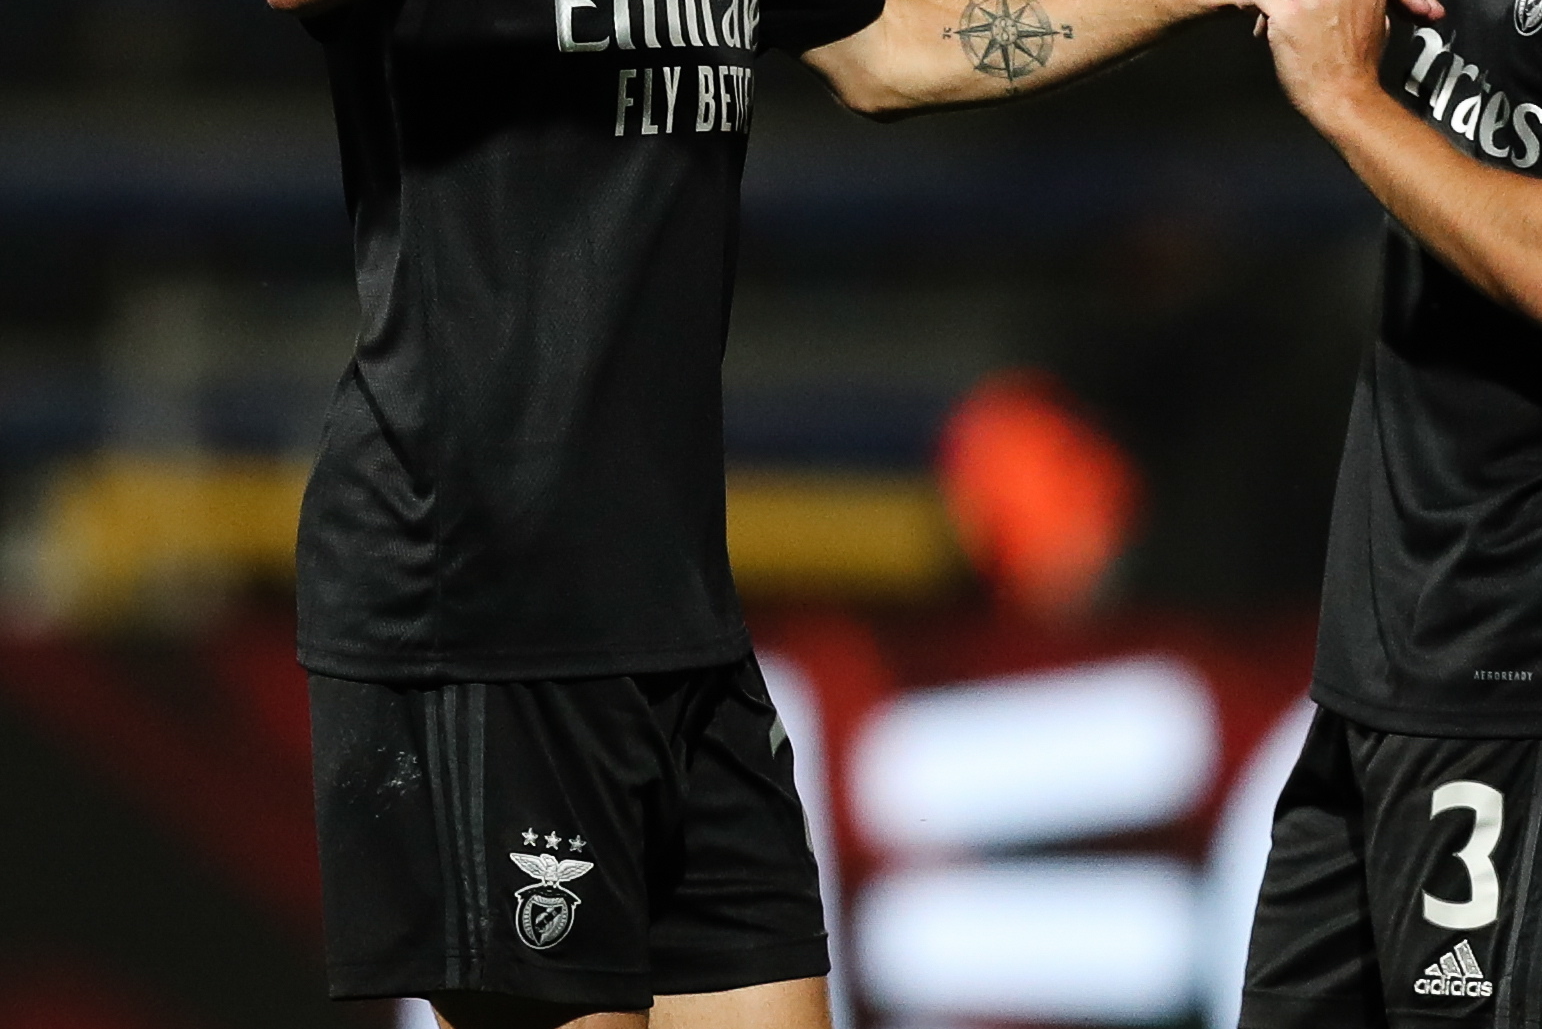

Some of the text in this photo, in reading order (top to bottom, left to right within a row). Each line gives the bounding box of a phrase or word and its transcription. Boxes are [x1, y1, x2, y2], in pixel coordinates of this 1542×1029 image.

[613, 65, 682, 137] FLY
[1472, 669, 1535, 682] AEROREADY
[1421, 779, 1505, 931] 3
[1413, 973, 1494, 998] adidas
